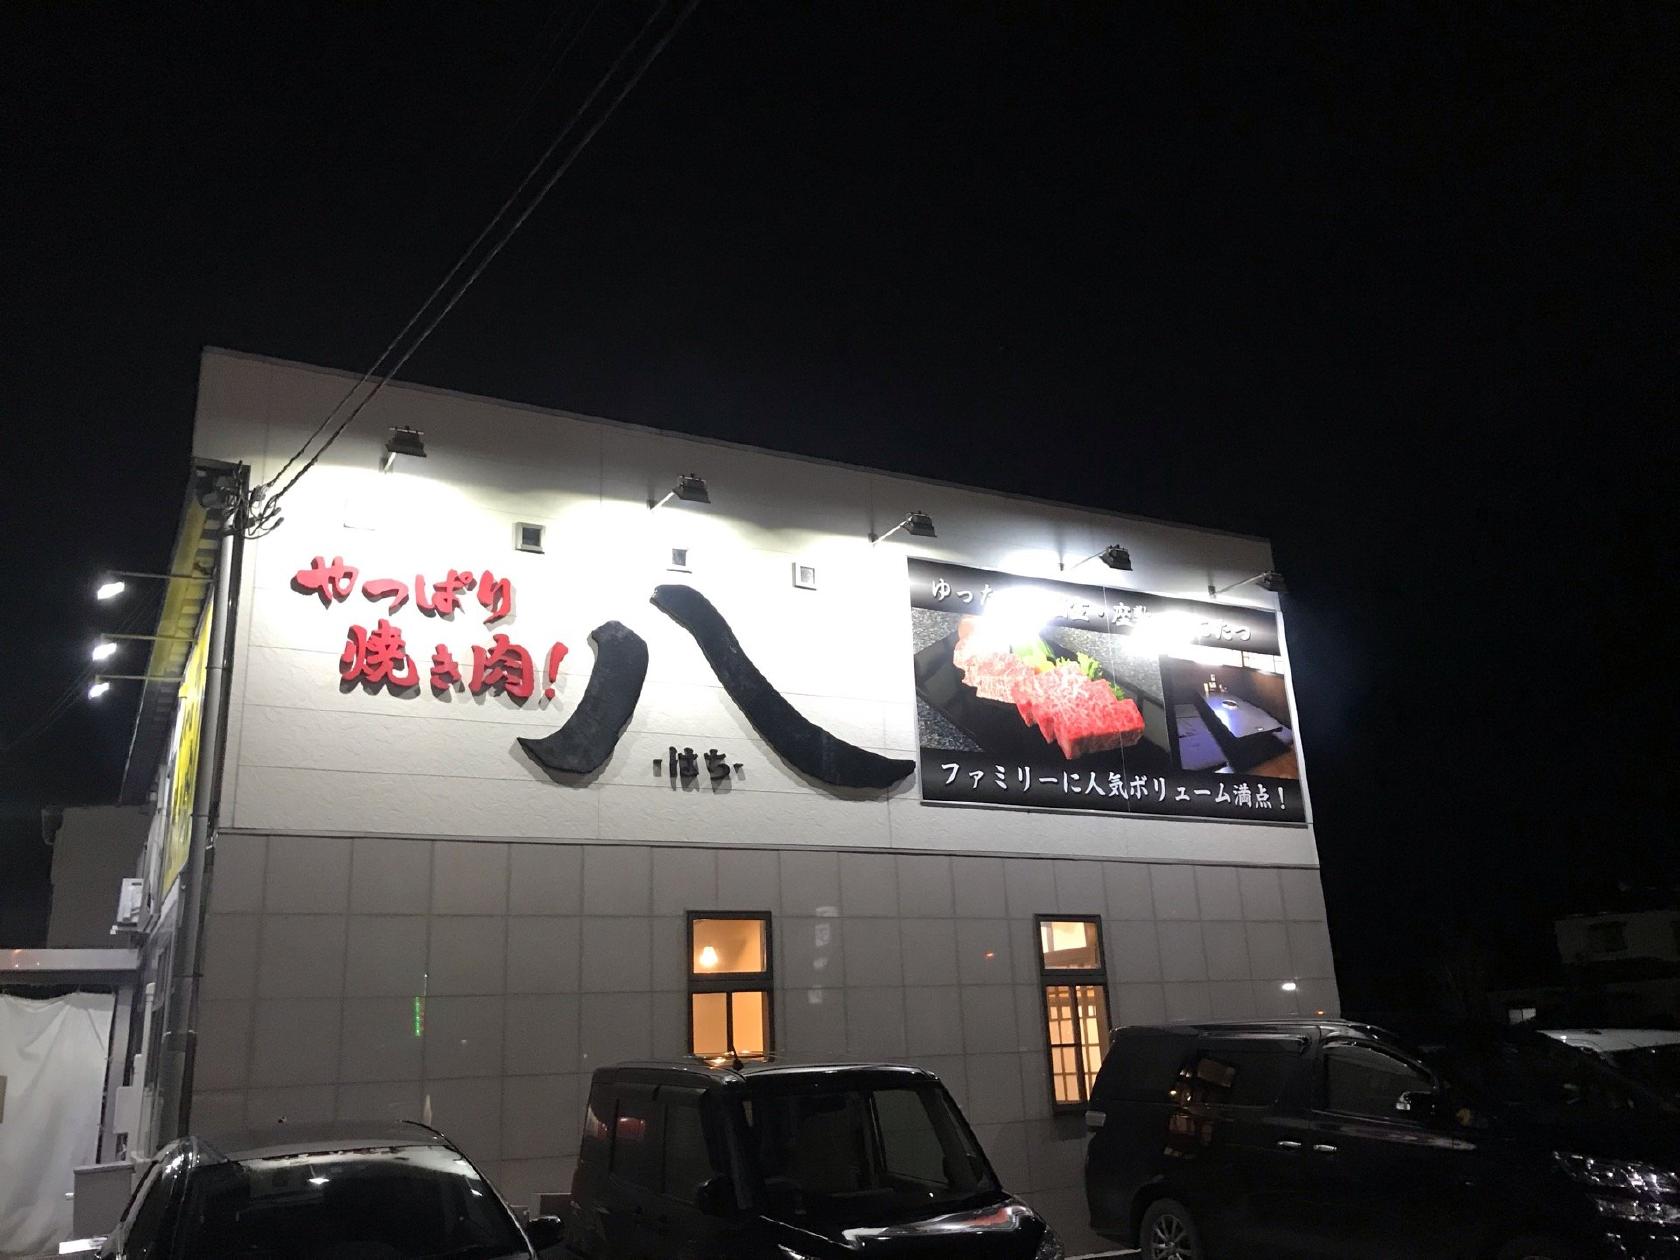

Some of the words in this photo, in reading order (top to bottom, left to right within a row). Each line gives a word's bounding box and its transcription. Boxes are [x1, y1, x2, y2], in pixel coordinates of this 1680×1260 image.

[291, 556, 513, 623] やっぱり
[518, 584, 916, 790] 八
